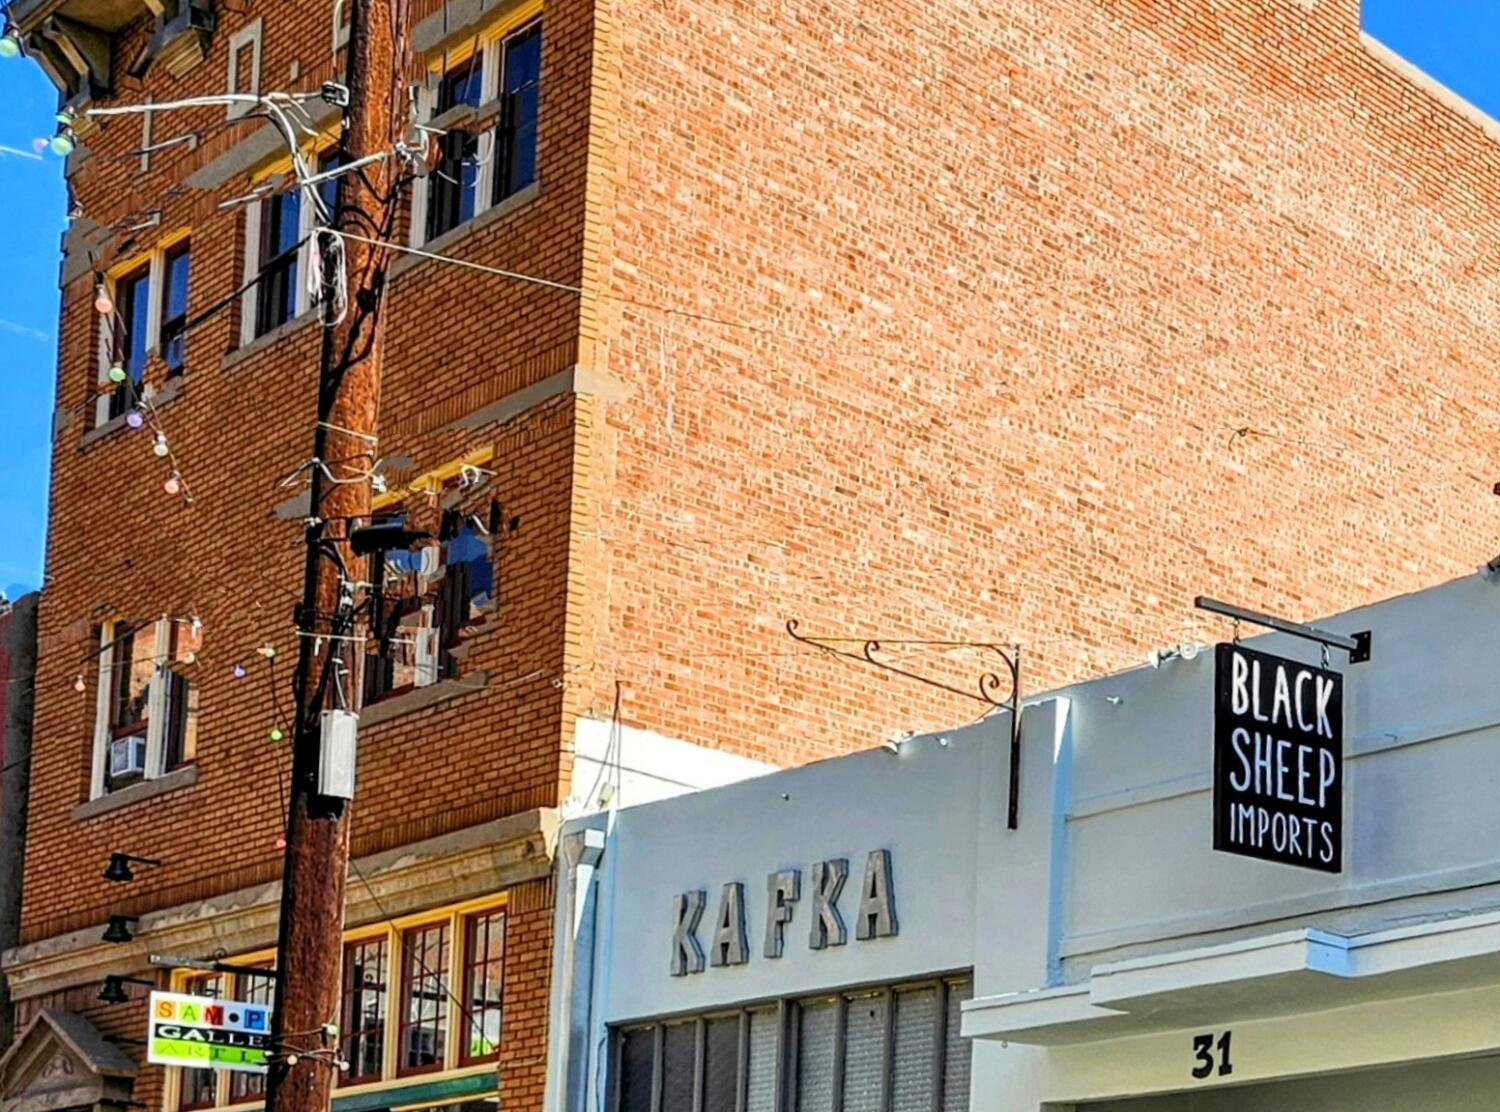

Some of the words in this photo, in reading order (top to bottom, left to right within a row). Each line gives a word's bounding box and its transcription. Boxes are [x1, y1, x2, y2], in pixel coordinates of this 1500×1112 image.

[1231, 651, 1335, 740] BLACK
[1229, 727, 1336, 809] SHEEP
[1229, 802, 1334, 863] IMPORTS
[670, 848, 900, 977] KAFKA
[157, 1025, 266, 1048] GALLE
[1191, 1030, 1233, 1079] 31
